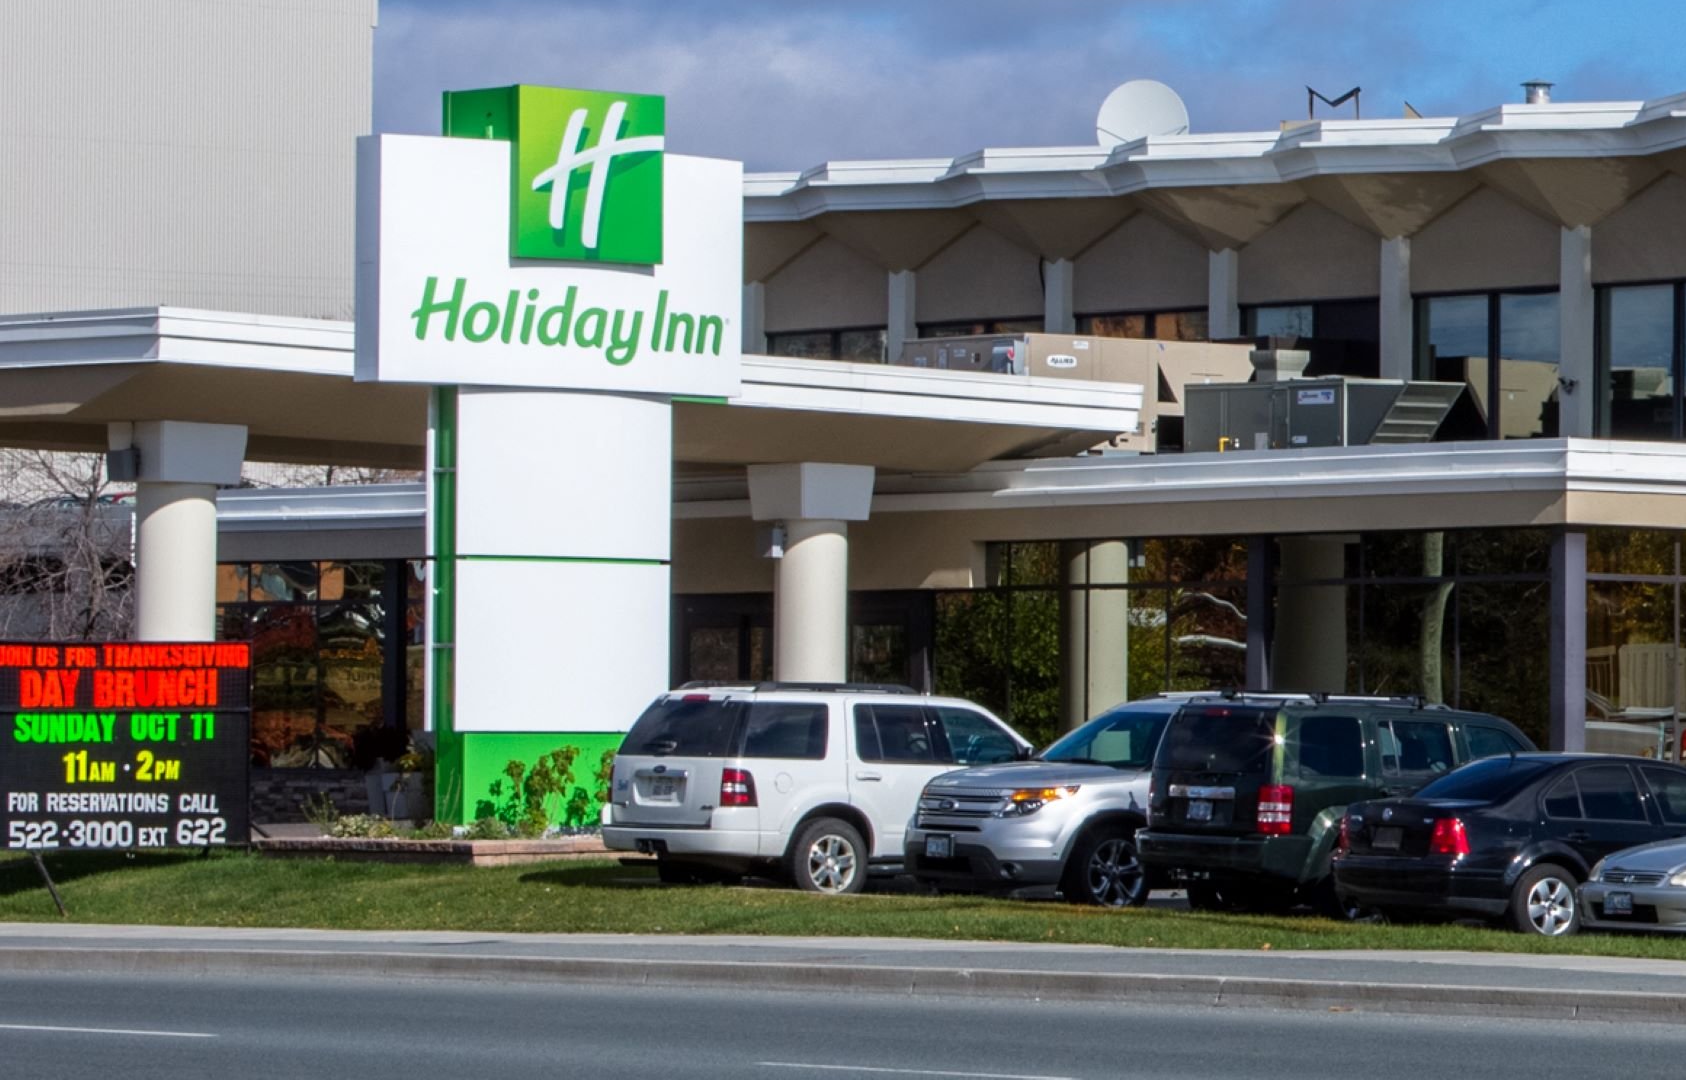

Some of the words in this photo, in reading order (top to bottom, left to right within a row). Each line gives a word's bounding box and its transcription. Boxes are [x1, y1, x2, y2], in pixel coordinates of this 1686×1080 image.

[411, 276, 644, 366] Holiday
[650, 289, 725, 356] Inn
[35, 646, 59, 667] US
[64, 646, 97, 667] FOR
[102, 644, 249, 668] THANKSGIVING
[20, 670, 80, 708] DAY
[93, 668, 219, 708] BRUNCH
[13, 712, 117, 743] SUNDAY
[130, 713, 181, 741] OCT
[190, 712, 215, 741] 11
[62, 750, 116, 783] 11AM
[135, 750, 181, 782] 2PM
[8, 792, 38, 812] FOR
[46, 792, 169, 813] RESERVATIONS
[179, 794, 219, 813] CALL
[138, 827, 167, 846] EXT
[176, 817, 226, 845] 622
